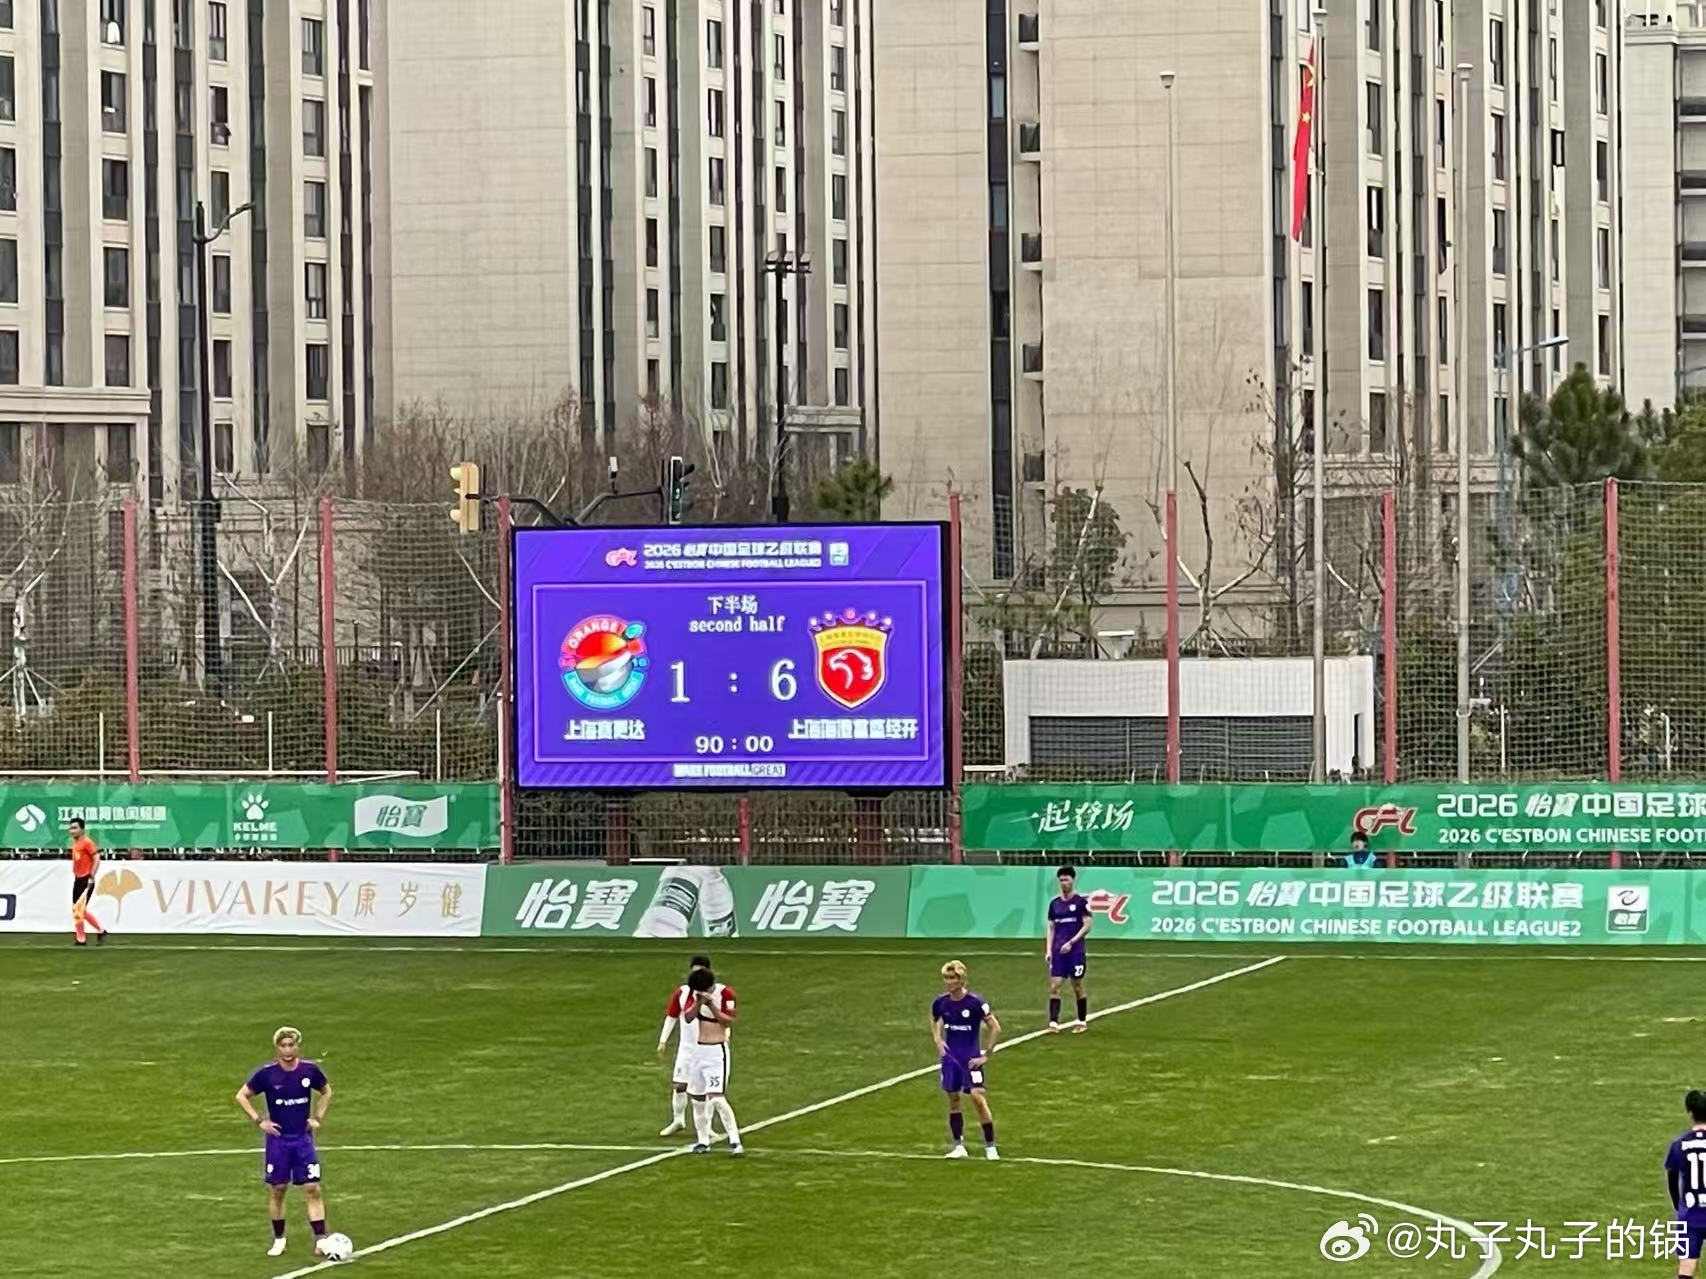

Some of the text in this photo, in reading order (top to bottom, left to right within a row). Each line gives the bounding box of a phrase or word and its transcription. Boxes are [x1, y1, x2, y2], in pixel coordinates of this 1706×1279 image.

[643, 543, 681, 557] 2026
[708, 595, 759, 615] 下半场
[689, 615, 785, 633] second half
[671, 660, 690, 702] 1
[771, 658, 798, 701] 6
[1008, 799, 1135, 834] 一起登场
[1437, 793, 1518, 818] 2026
[233, 821, 278, 832] KELME
[1439, 828, 1481, 844] 2026
[1485, 827, 1571, 845] C'ESTBON
[1576, 828, 1651, 844] CHINESE
[152, 879, 351, 916] VIVAKEY
[515, 878, 638, 930] 怡寶
[750, 878, 875, 932] 怡寶
[1152, 880, 1241, 906] 2026
[1151, 917, 1582, 937] 2026 C'ESTBON CHINESE FOOTBALL LEAGUE2
